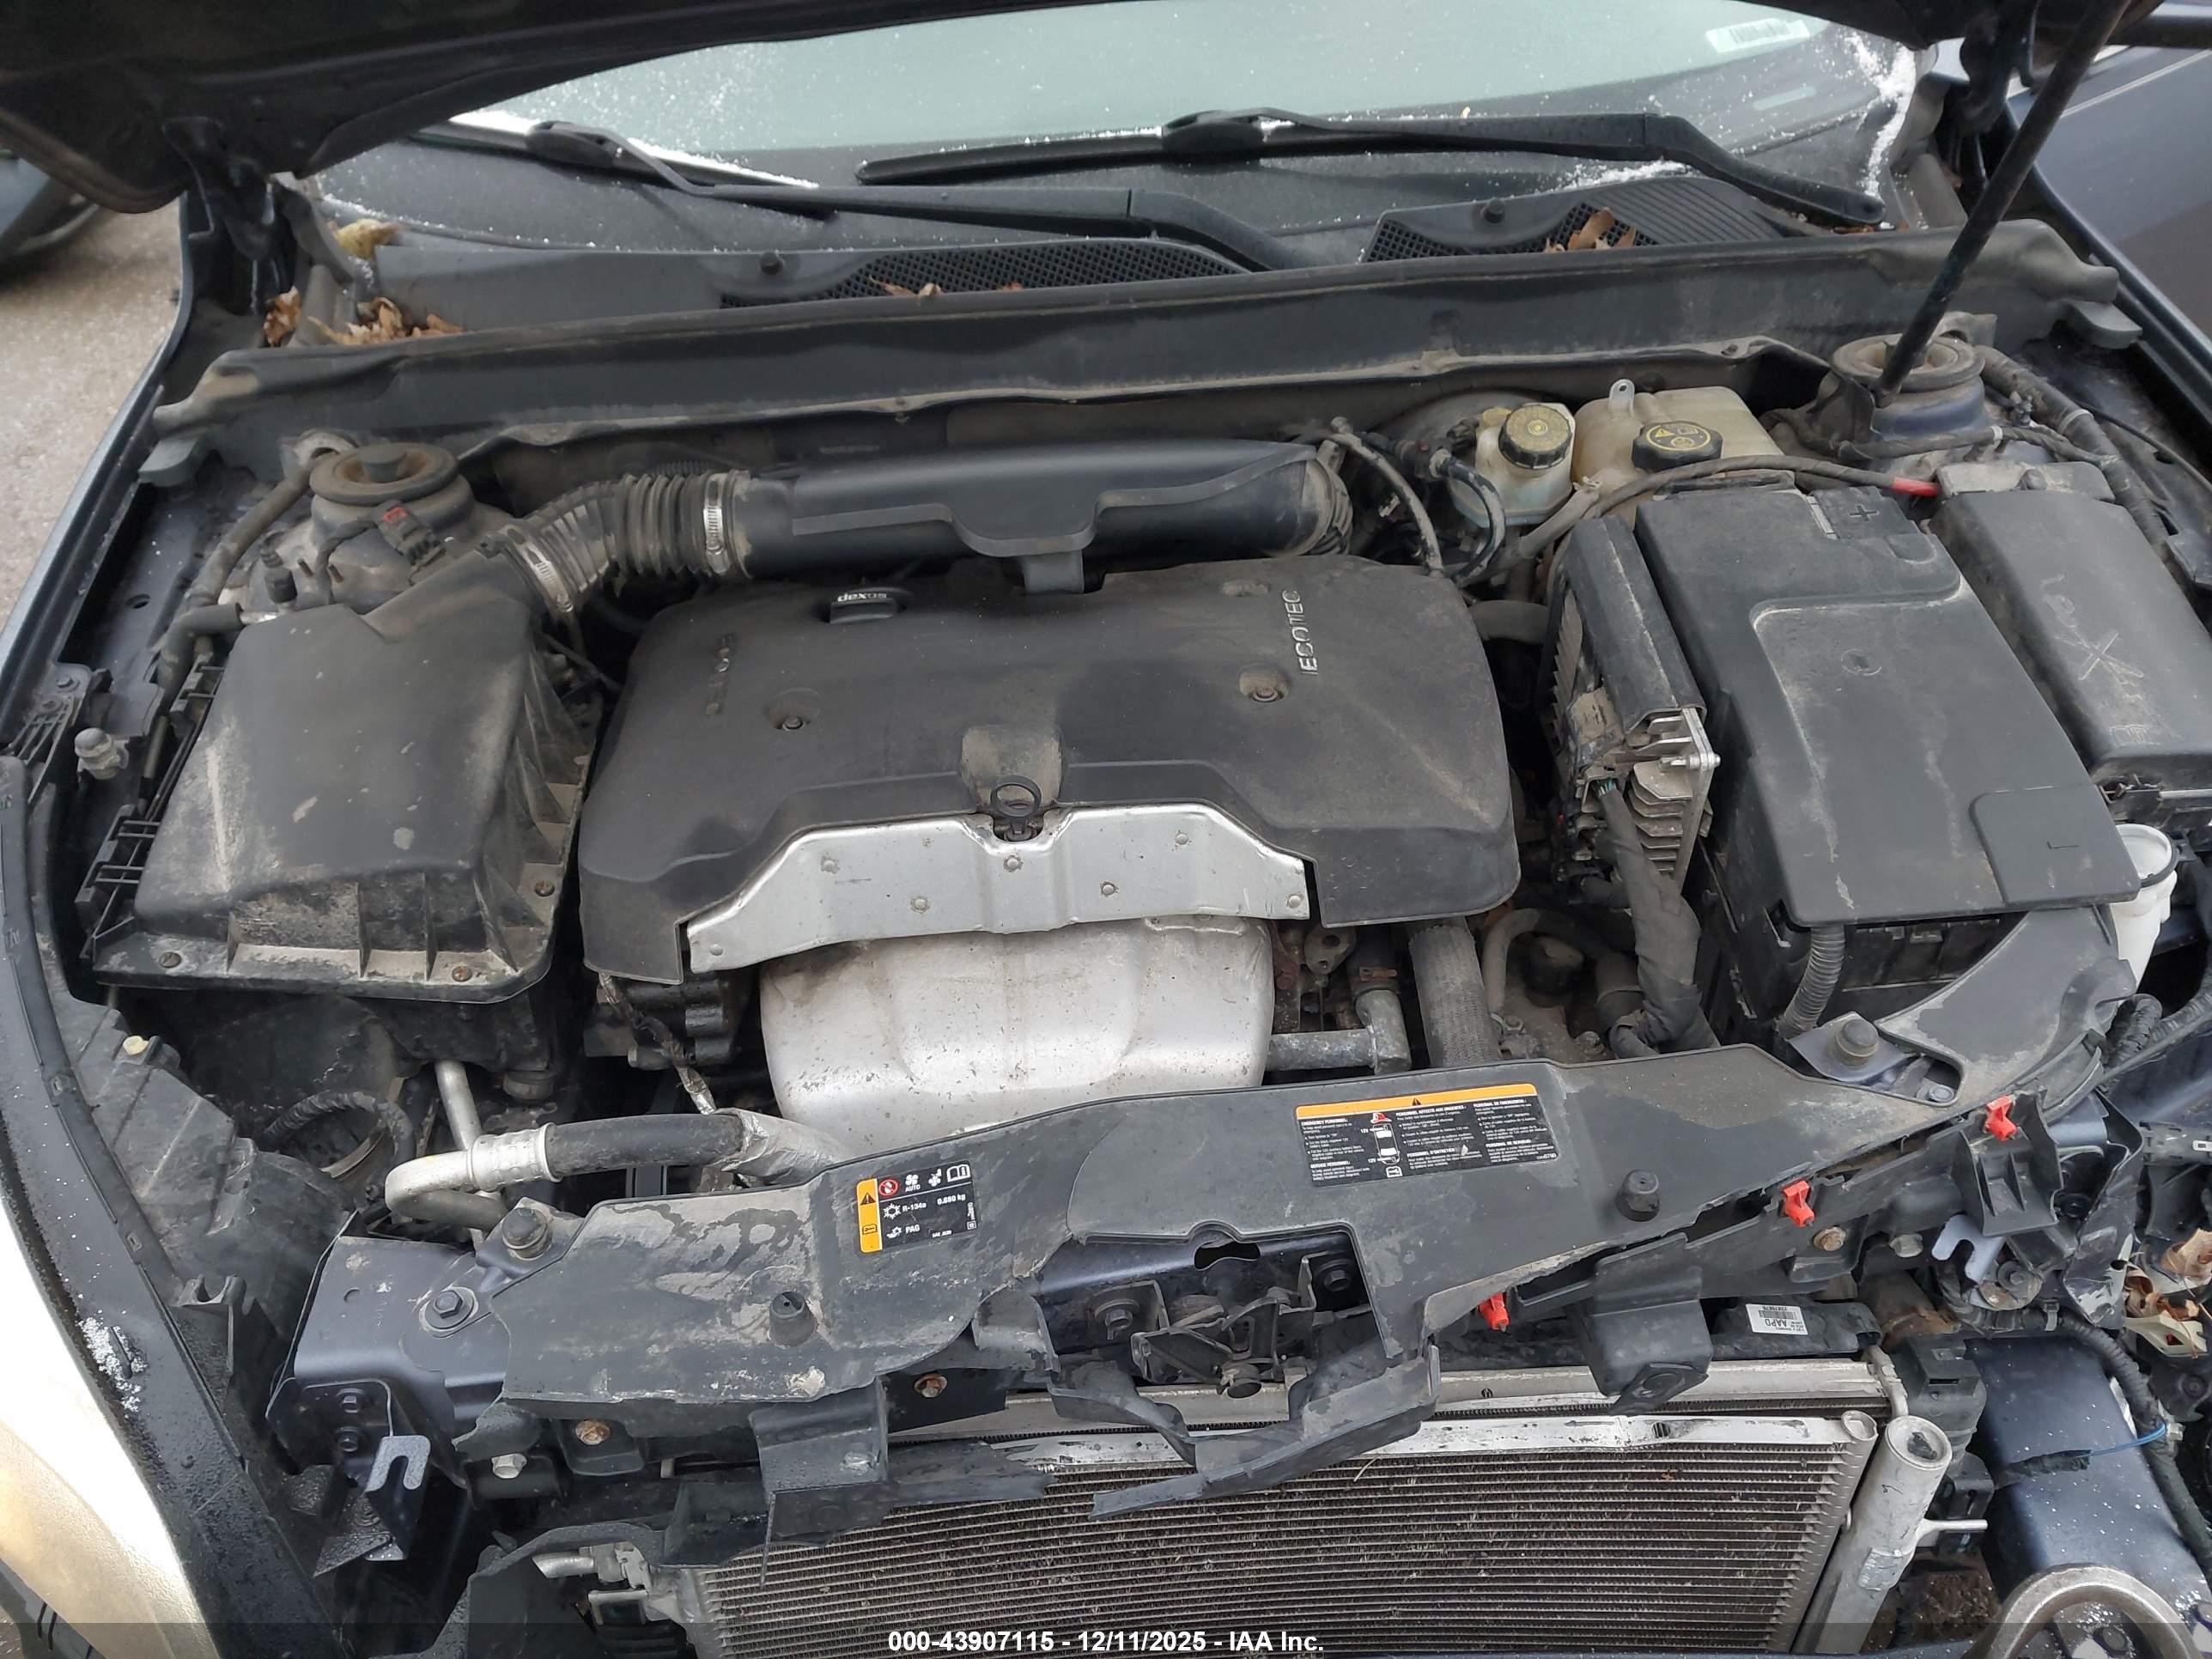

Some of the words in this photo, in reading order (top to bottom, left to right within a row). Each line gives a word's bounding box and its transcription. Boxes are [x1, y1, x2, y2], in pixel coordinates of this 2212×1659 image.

[1282, 590, 1319, 675] ECOTEC
[902, 1203, 927, 1212] R-134a
[905, 1224, 921, 1233] PAG
